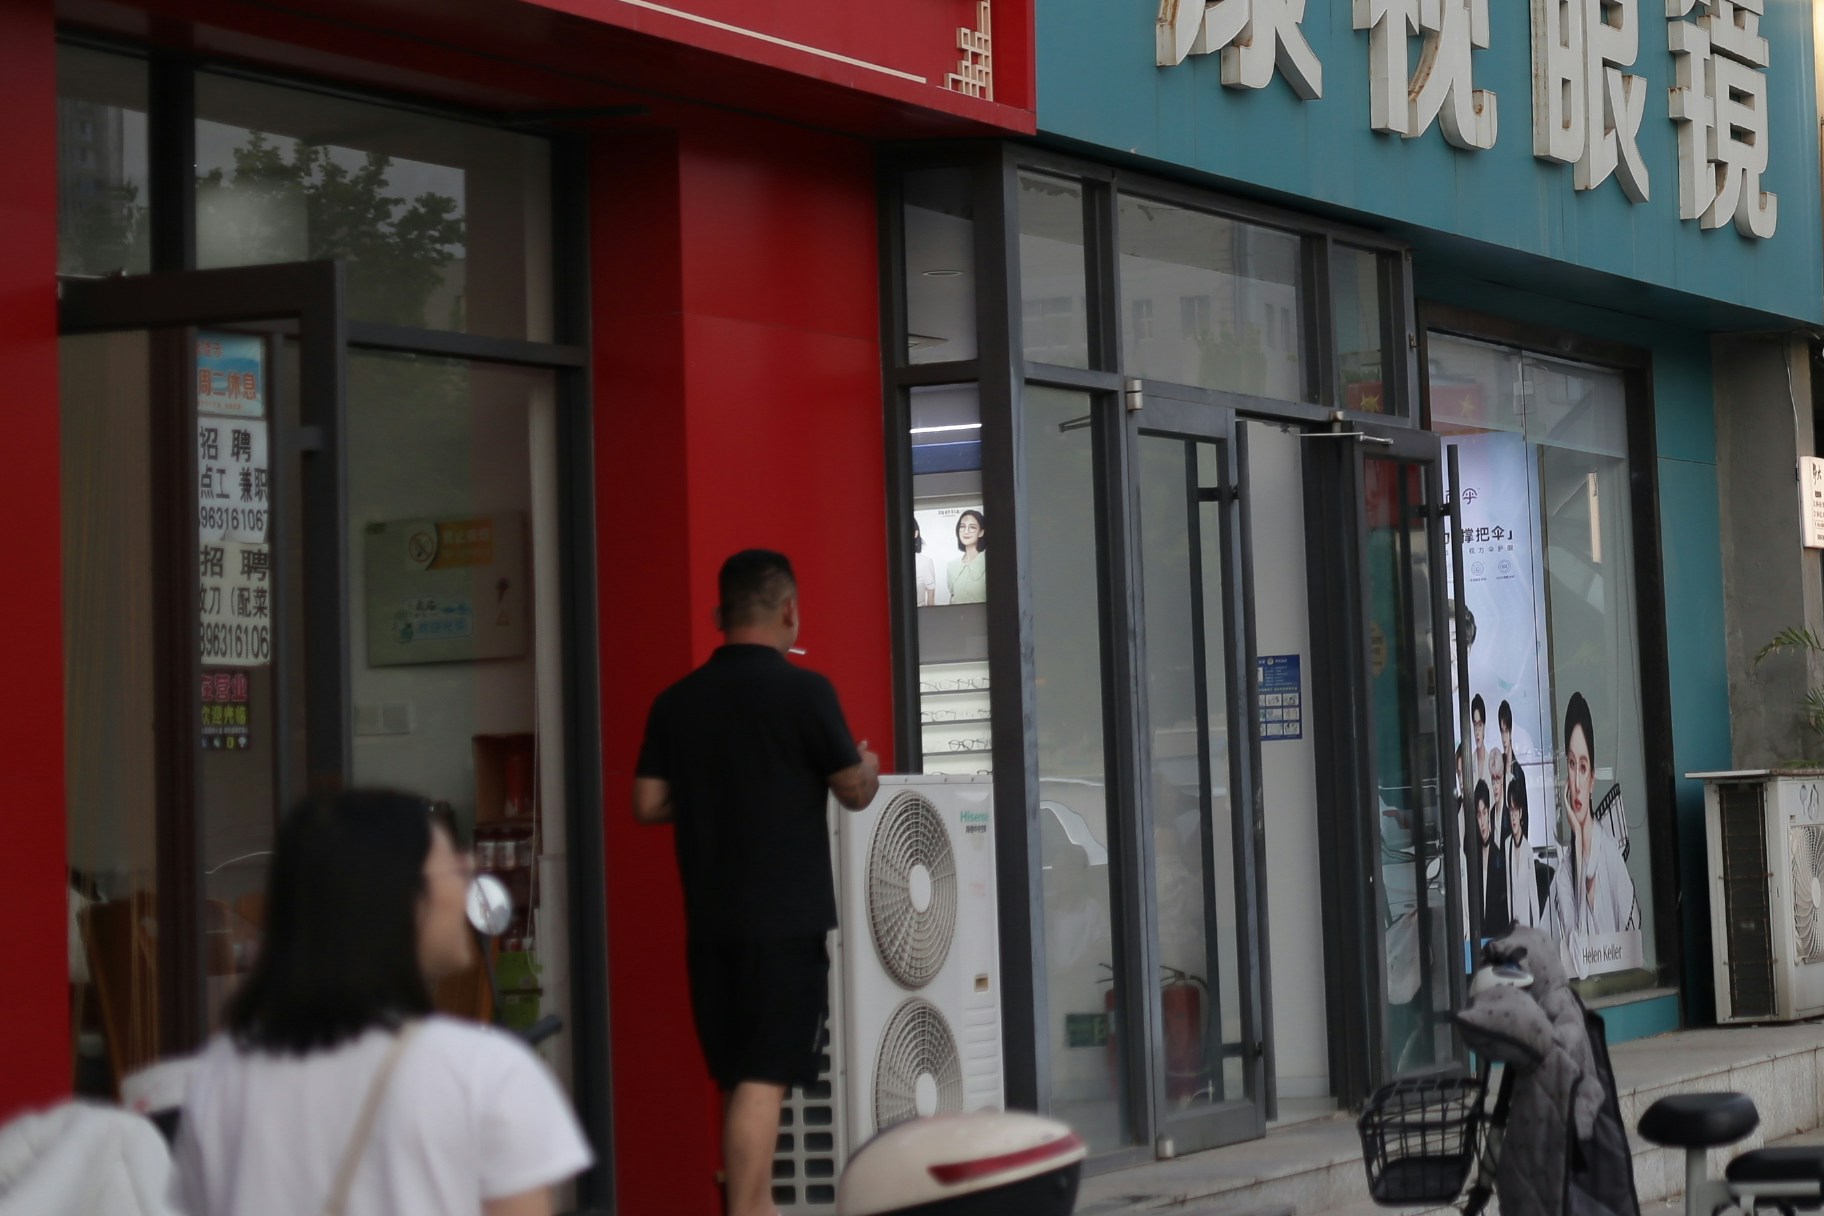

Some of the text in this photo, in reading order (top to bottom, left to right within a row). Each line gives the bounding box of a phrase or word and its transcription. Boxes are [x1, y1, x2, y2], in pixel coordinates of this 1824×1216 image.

[199, 426, 252, 464] 招聘
[238, 467, 268, 503] 兼职
[200, 546, 269, 582] 招聘
[1582, 944, 1622, 964] Helen Keller
